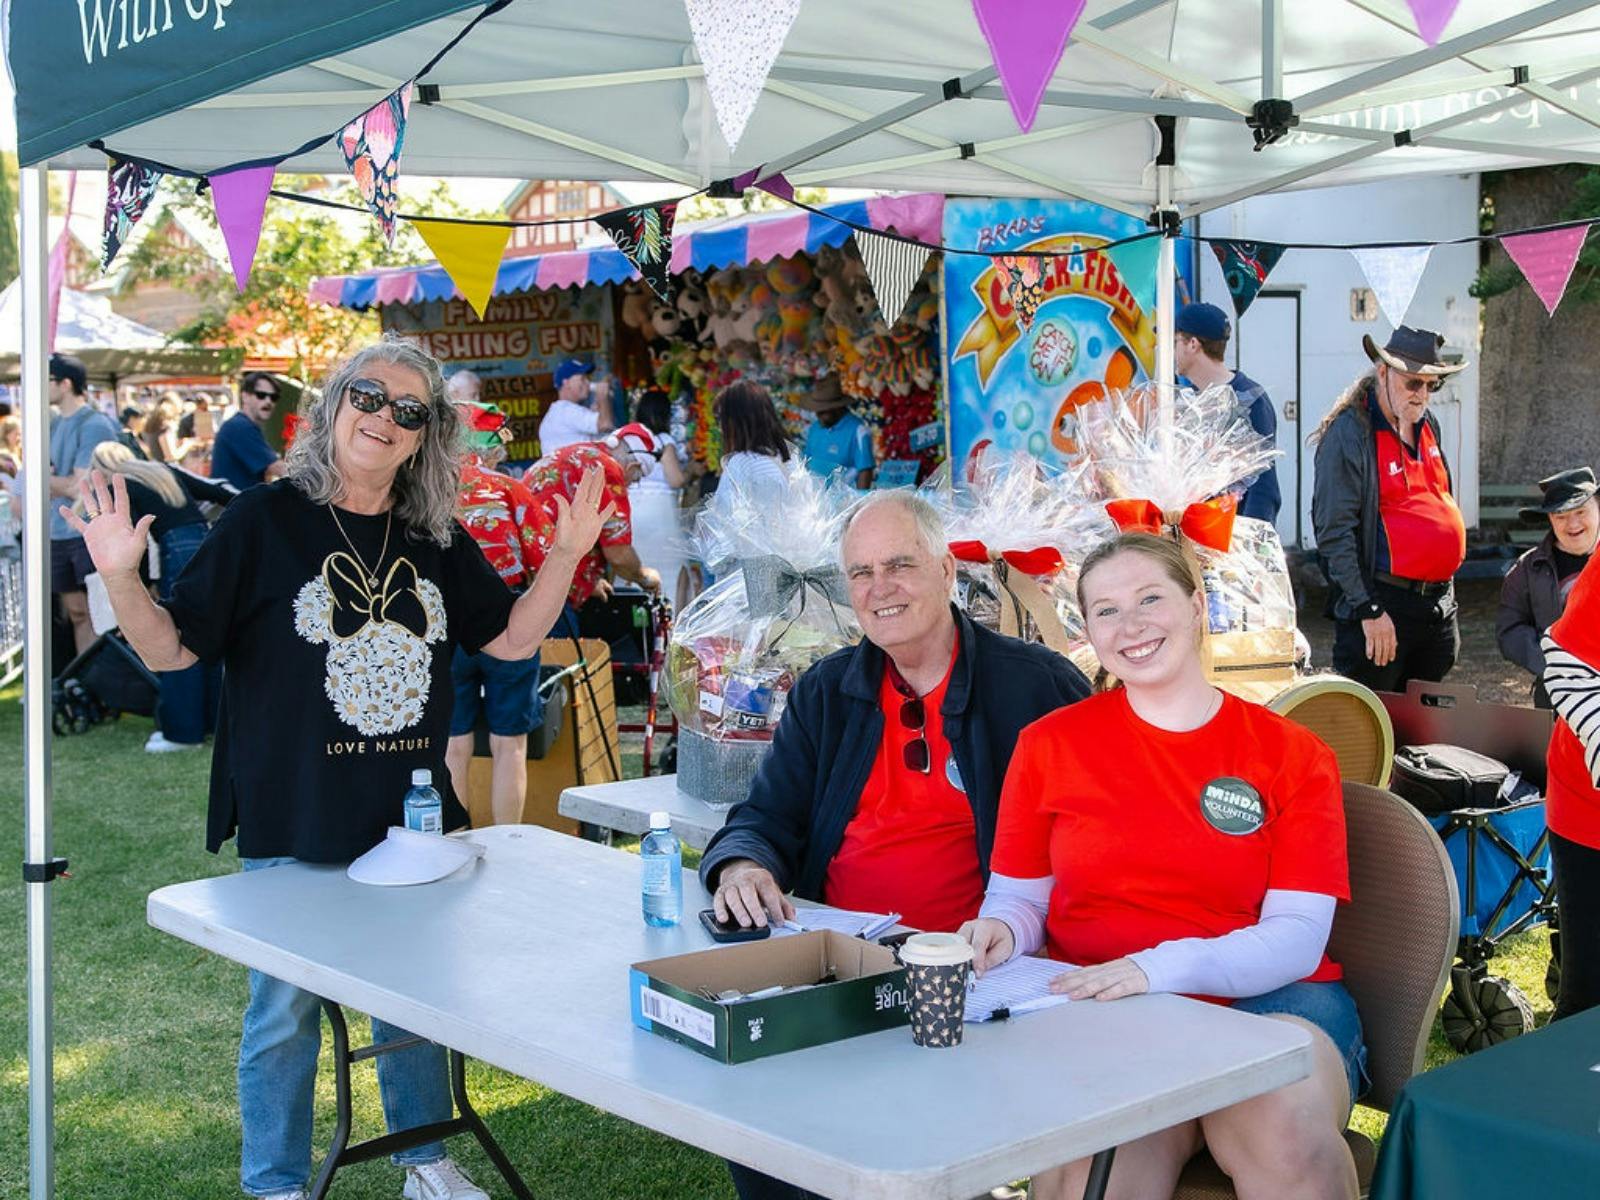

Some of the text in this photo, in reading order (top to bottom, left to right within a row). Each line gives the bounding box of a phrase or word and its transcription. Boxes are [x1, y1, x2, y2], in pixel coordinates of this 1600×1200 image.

[976, 216, 1045, 252] BRADS
[405, 323, 601, 360] ISHING FUN
[484, 376, 536, 394] ATCH
[497, 399, 540, 416] OUR
[326, 737, 430, 755] LOVE NATURE
